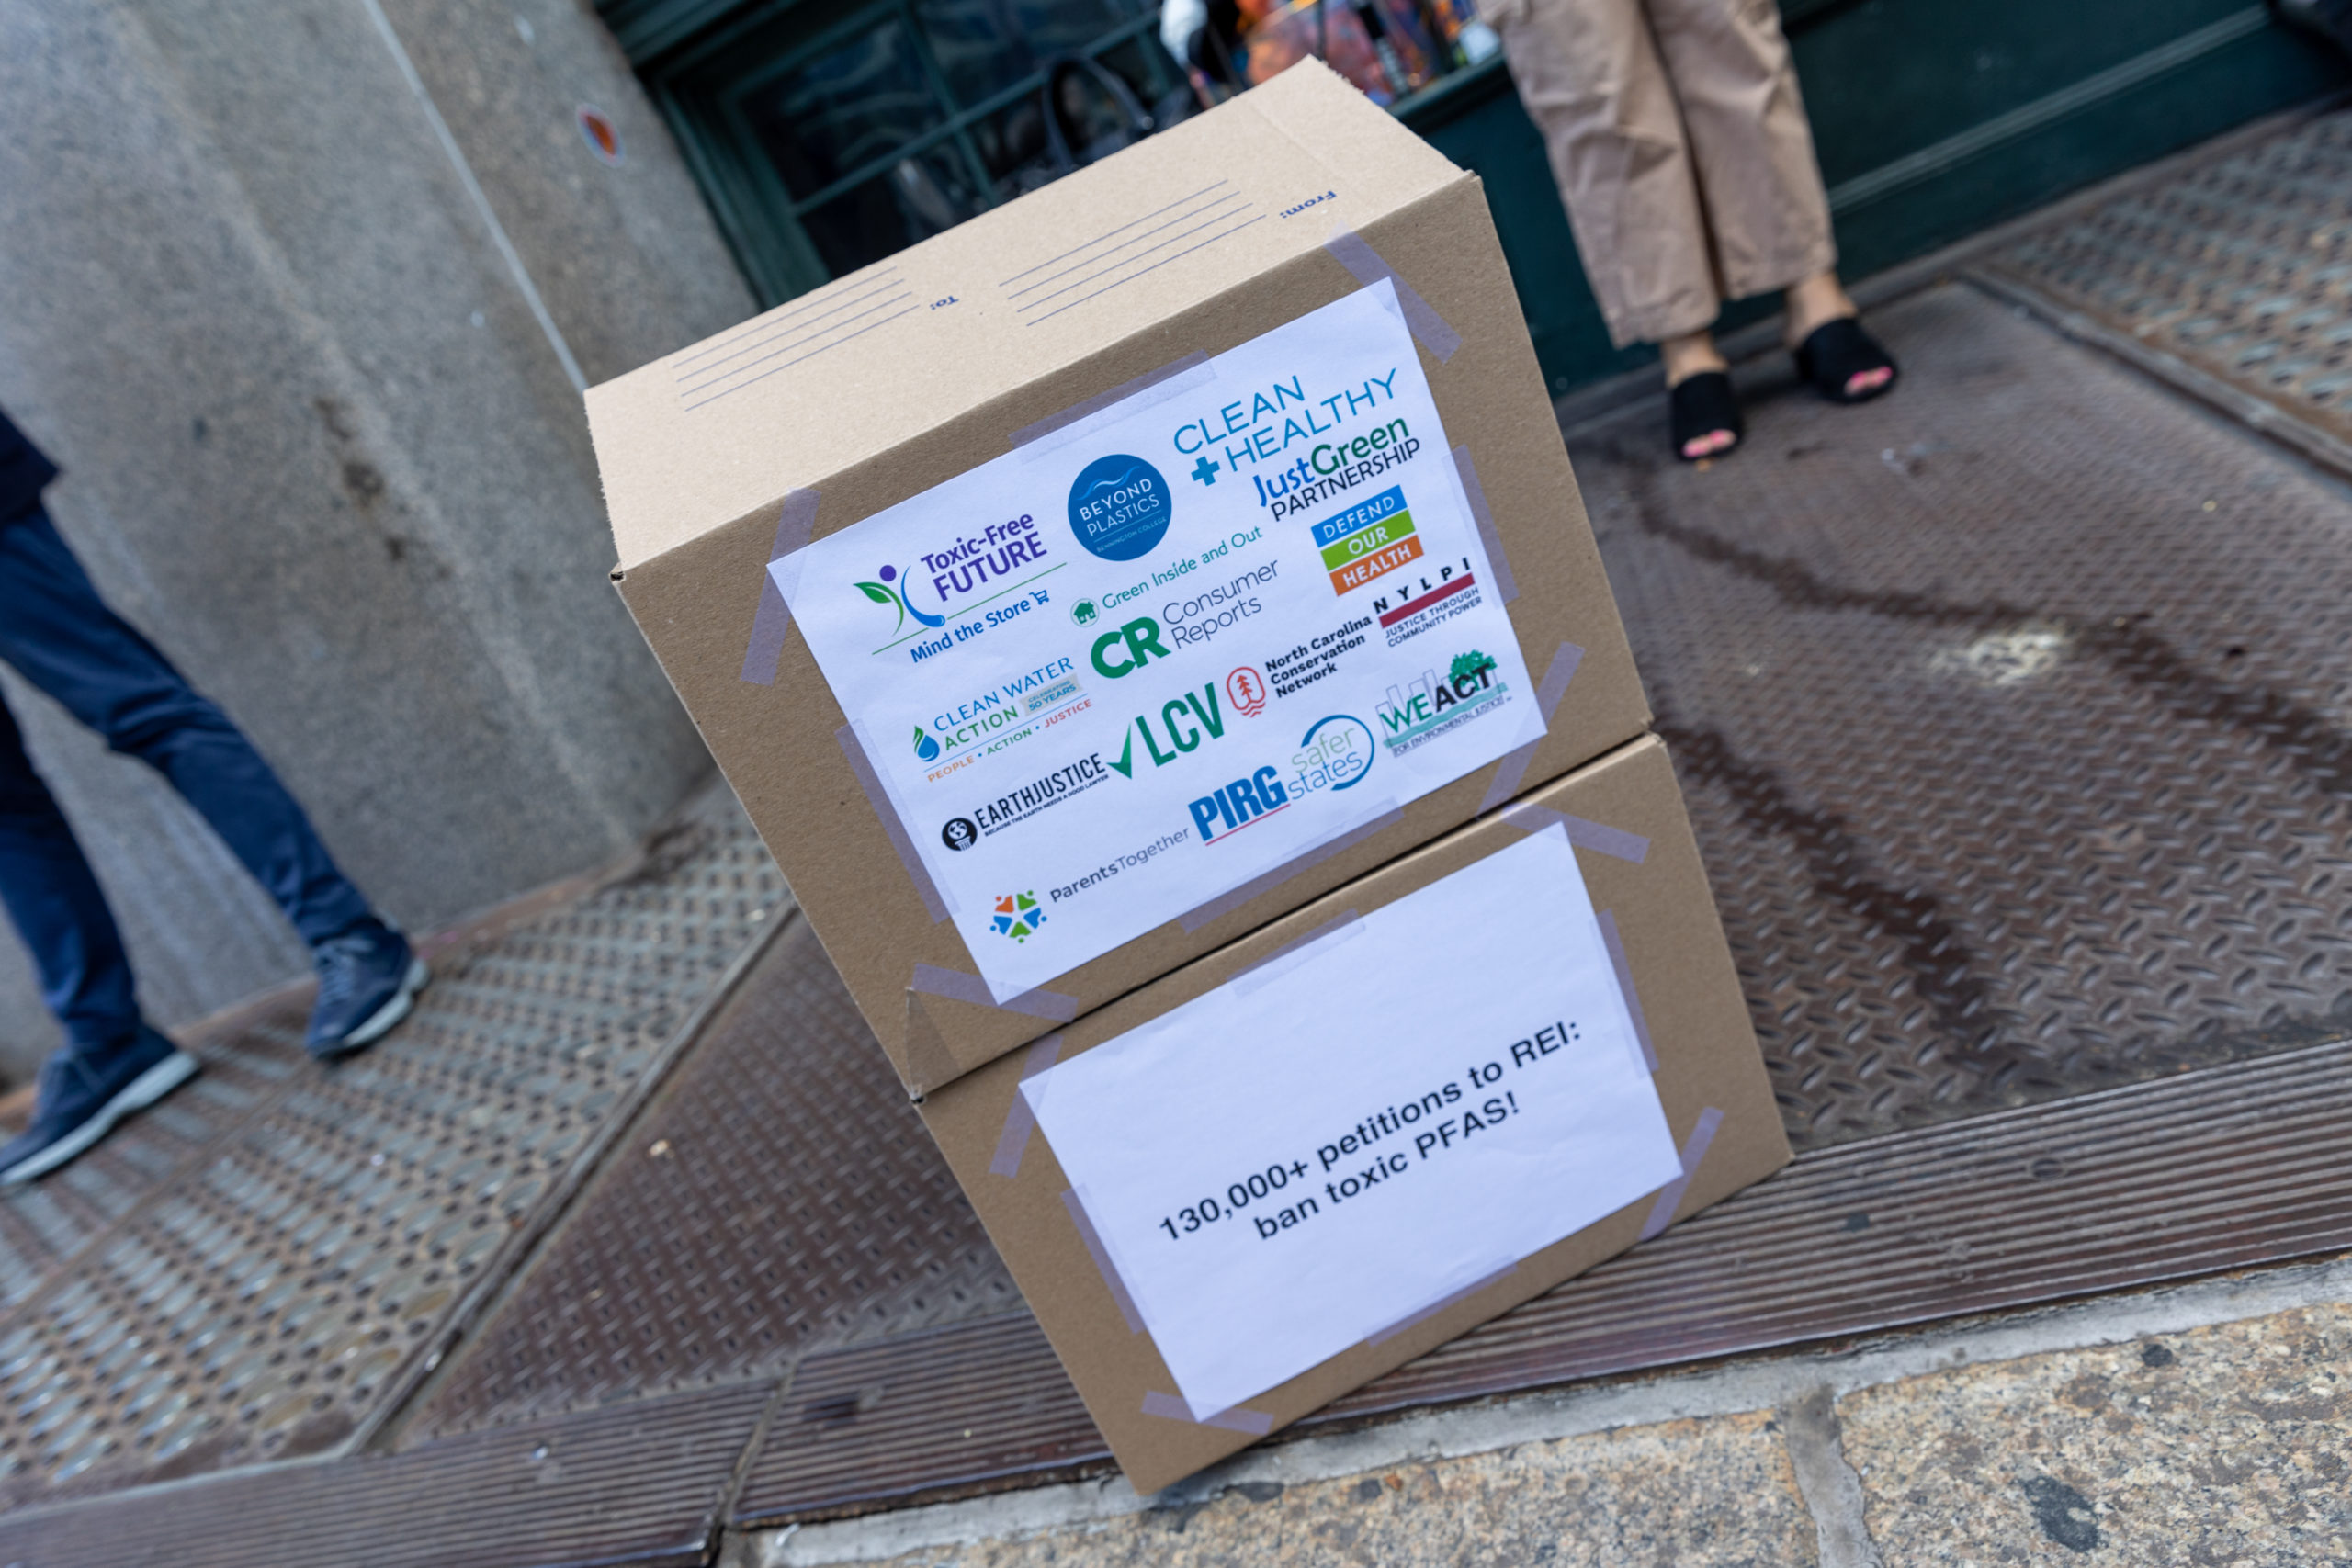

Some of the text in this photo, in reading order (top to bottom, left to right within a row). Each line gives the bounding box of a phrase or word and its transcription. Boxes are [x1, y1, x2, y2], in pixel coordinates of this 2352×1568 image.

[1280, 191, 1337, 219] From:
[930, 295, 960, 310] To:
[1174, 375, 1305, 454] CLEAN
[1225, 367, 1396, 472] HEALTHY
[1079, 478, 1153, 521] BEYOND
[1270, 437, 1420, 522] PARTNERSHIP
[921, 514, 1035, 574] Toxic-Free
[1087, 494, 1159, 536] PLASTICS
[1323, 496, 1395, 539] DEFEND
[1348, 526, 1389, 555] OUR
[933, 531, 1047, 602] FUTURE
[1102, 526, 1263, 609] Green Inside and Out
[1163, 559, 1279, 625] Consumer
[1342, 544, 1412, 588] HEALTH
[910, 600, 1031, 663] Mind the Store
[1171, 597, 1261, 649] Reports
[1385, 587, 1479, 638] JUSTICE THROUGH
[1388, 596, 1482, 647] COMMUNITY POWER
[1091, 616, 1172, 679] CR
[1265, 615, 1372, 672] North Carolina
[1271, 634, 1366, 685] Conservation
[933, 657, 1073, 731] CLEAN WATER
[1029, 684, 1076, 711] 50 YEARS
[1276, 662, 1338, 698] Network
[927, 698, 1092, 782] PEOPLE ACTION JUSTICE
[944, 705, 1019, 750] ACTION
[1136, 682, 1225, 767] LCV
[1291, 727, 1355, 773] safer
[1410, 713, 1475, 747] ENVIRONMENTAL
[974, 752, 1106, 829] EARTHJUSTICE
[1188, 765, 1288, 841] PIRG
[1288, 751, 1363, 800] states
[984, 820, 1011, 837] BECAUSE
[1011, 816, 1023, 824] THE
[1023, 806, 1043, 818] EARTH
[1043, 796, 1063, 808] NEEDS
[1085, 773, 1109, 789] LAWYER
[1049, 828, 1190, 903] ParentsTogether
[1159, 1020, 1581, 1240] 130,000+ petitions to REI:
[1253, 1089, 1521, 1240] ban toxic PFAS!
